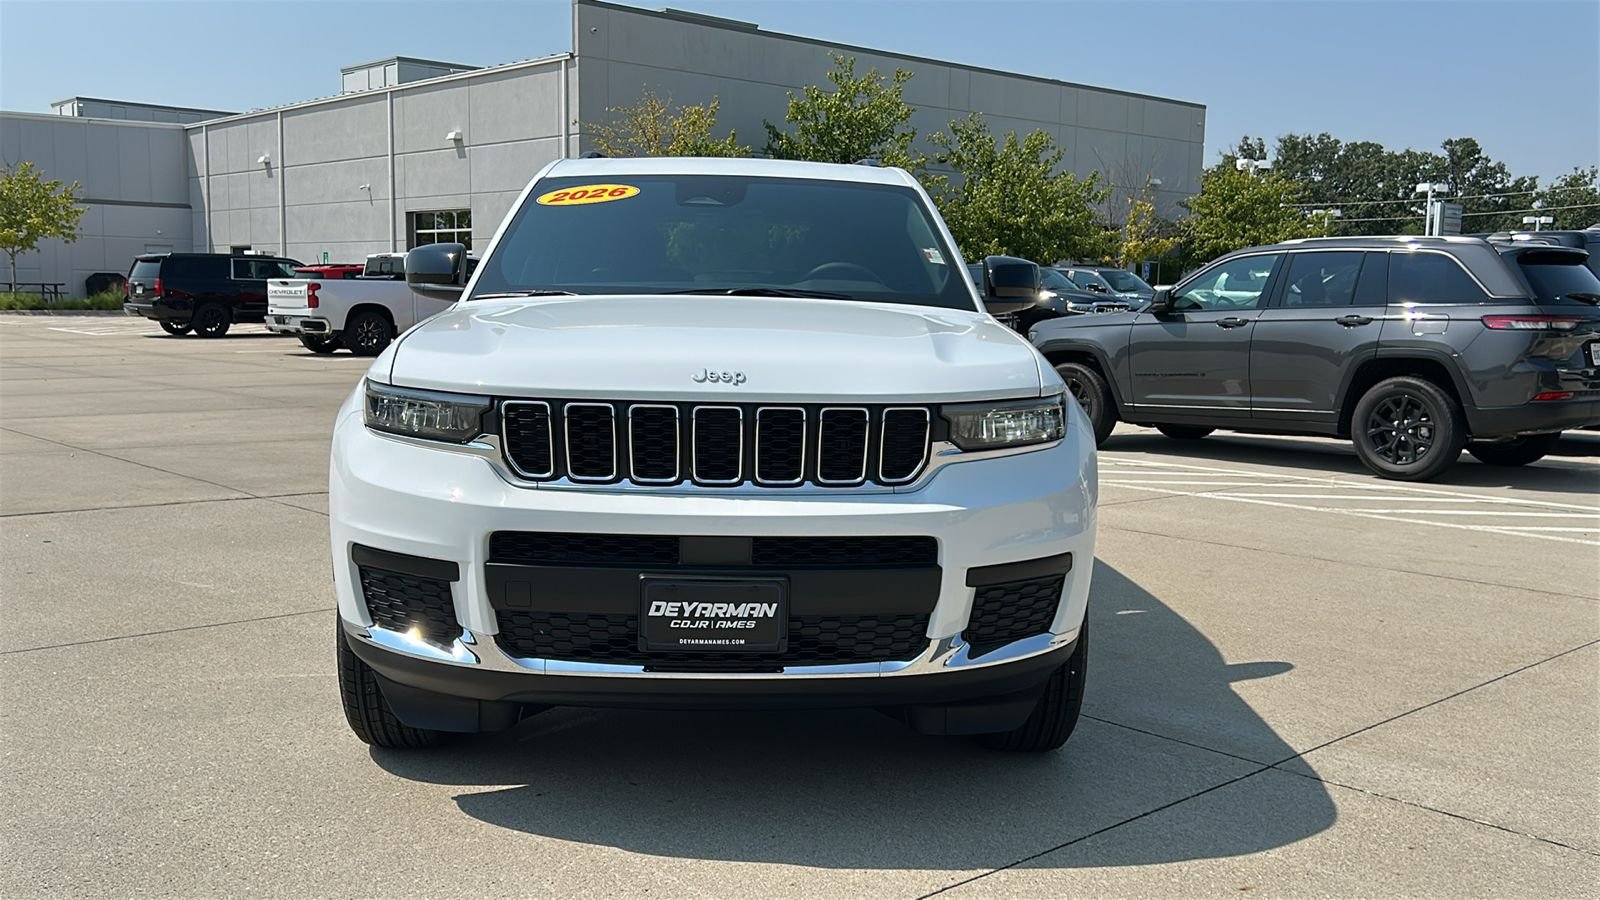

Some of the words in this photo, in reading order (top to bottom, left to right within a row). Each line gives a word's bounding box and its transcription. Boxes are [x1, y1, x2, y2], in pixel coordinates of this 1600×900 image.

[547, 188, 628, 203] 2026
[691, 368, 747, 386] Jeep
[648, 601, 778, 618] DEYARMAN
[715, 620, 756, 629] AMES
